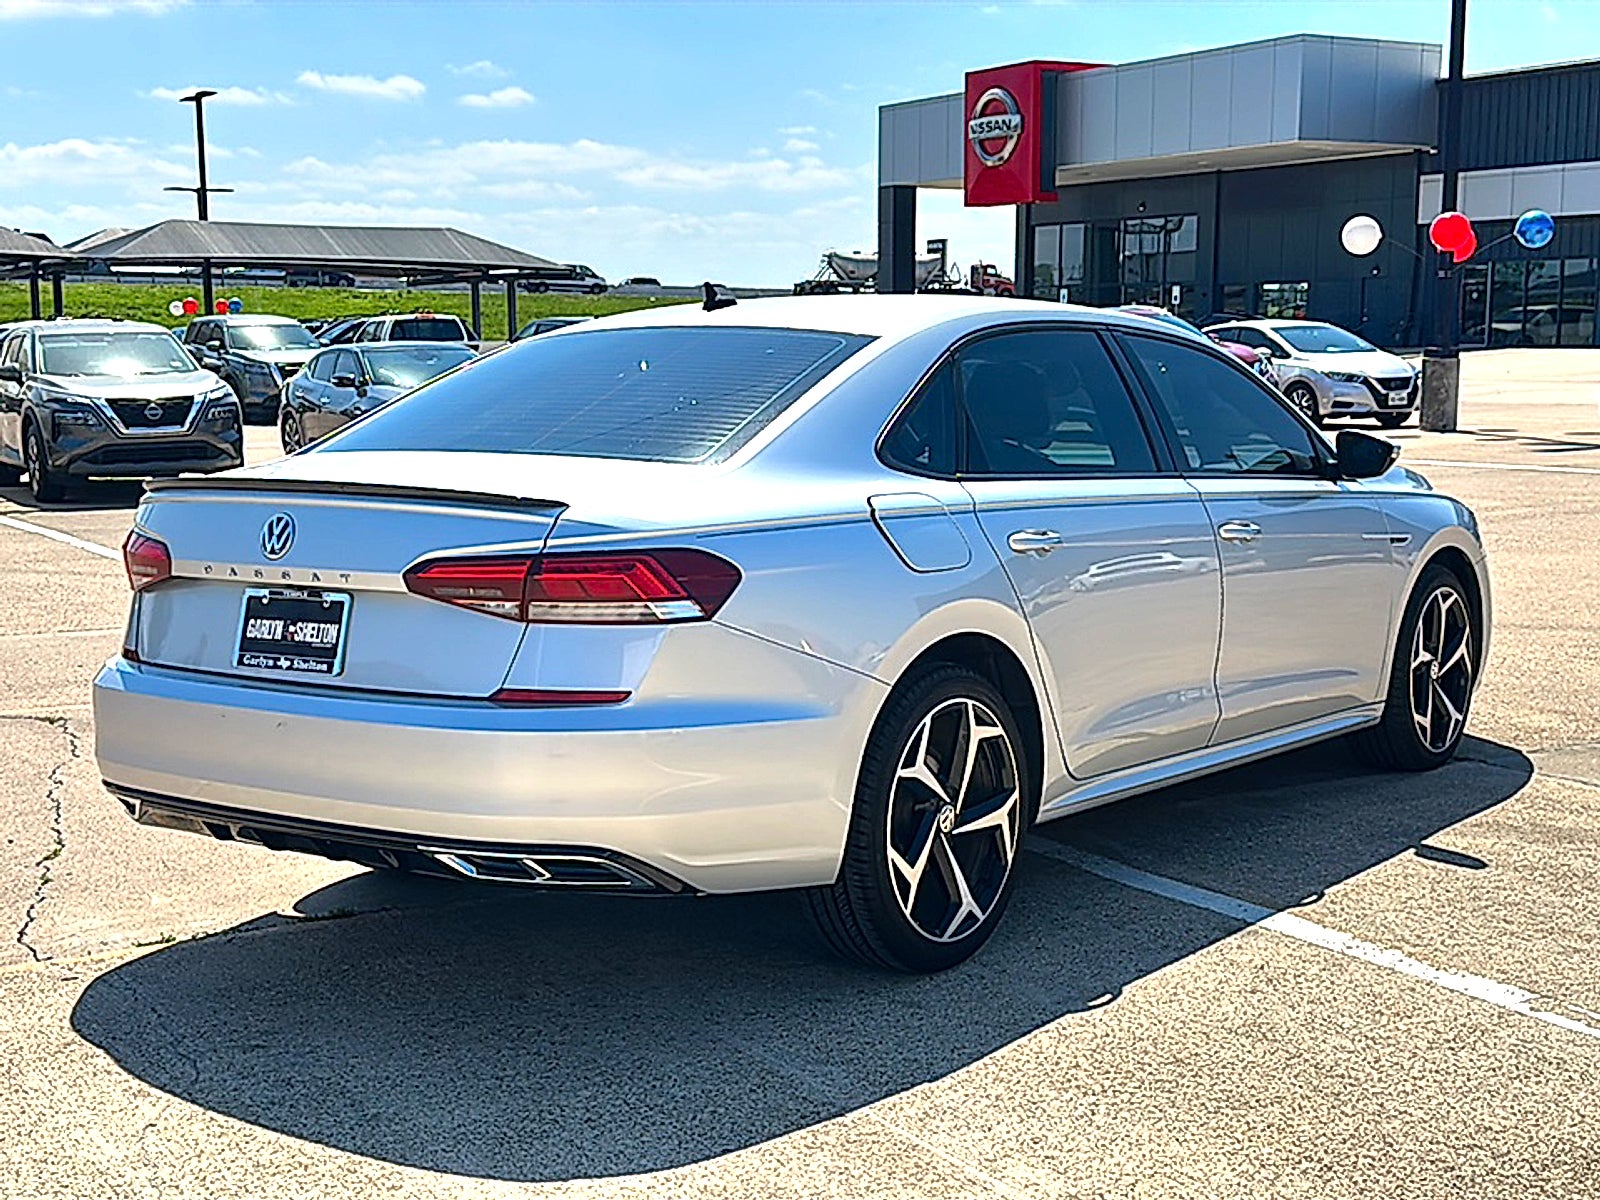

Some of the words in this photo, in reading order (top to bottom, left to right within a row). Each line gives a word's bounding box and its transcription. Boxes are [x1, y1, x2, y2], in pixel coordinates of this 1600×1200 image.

[204, 564, 351, 583] PASSAT
[246, 619, 284, 640] GARLYN
[294, 622, 339, 644] SHELTON
[242, 654, 275, 669] Garlyn
[292, 658, 329, 672] Shelton
